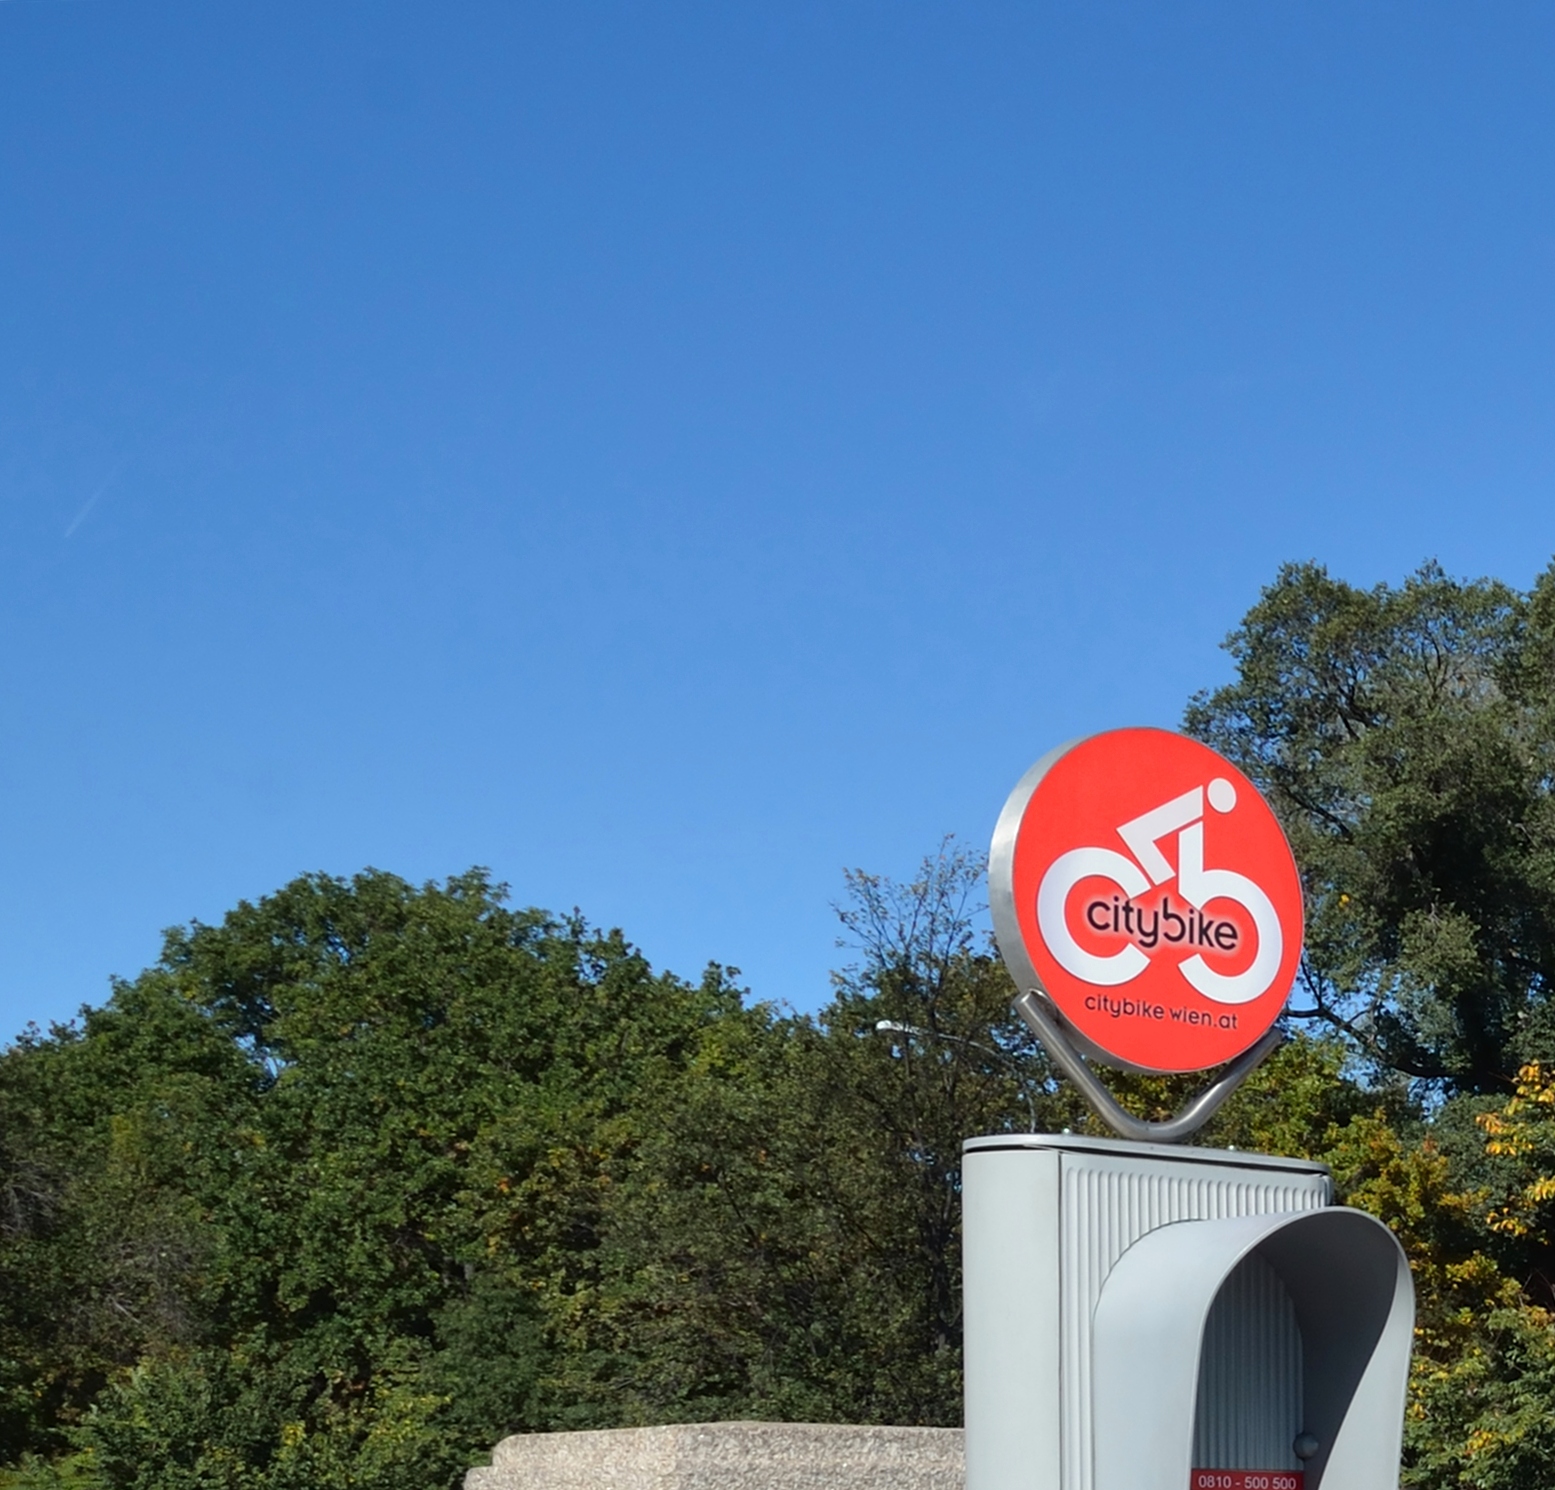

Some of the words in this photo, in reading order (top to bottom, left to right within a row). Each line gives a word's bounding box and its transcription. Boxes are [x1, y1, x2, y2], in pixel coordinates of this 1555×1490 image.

[1086, 895, 1238, 951] citybike
[1084, 993, 1165, 1019] citybike
[1169, 1006, 1238, 1030] wien.at
[1198, 1475, 1232, 1489] 0810
[1244, 1476, 1268, 1490] 500
[1272, 1477, 1296, 1490] 500
